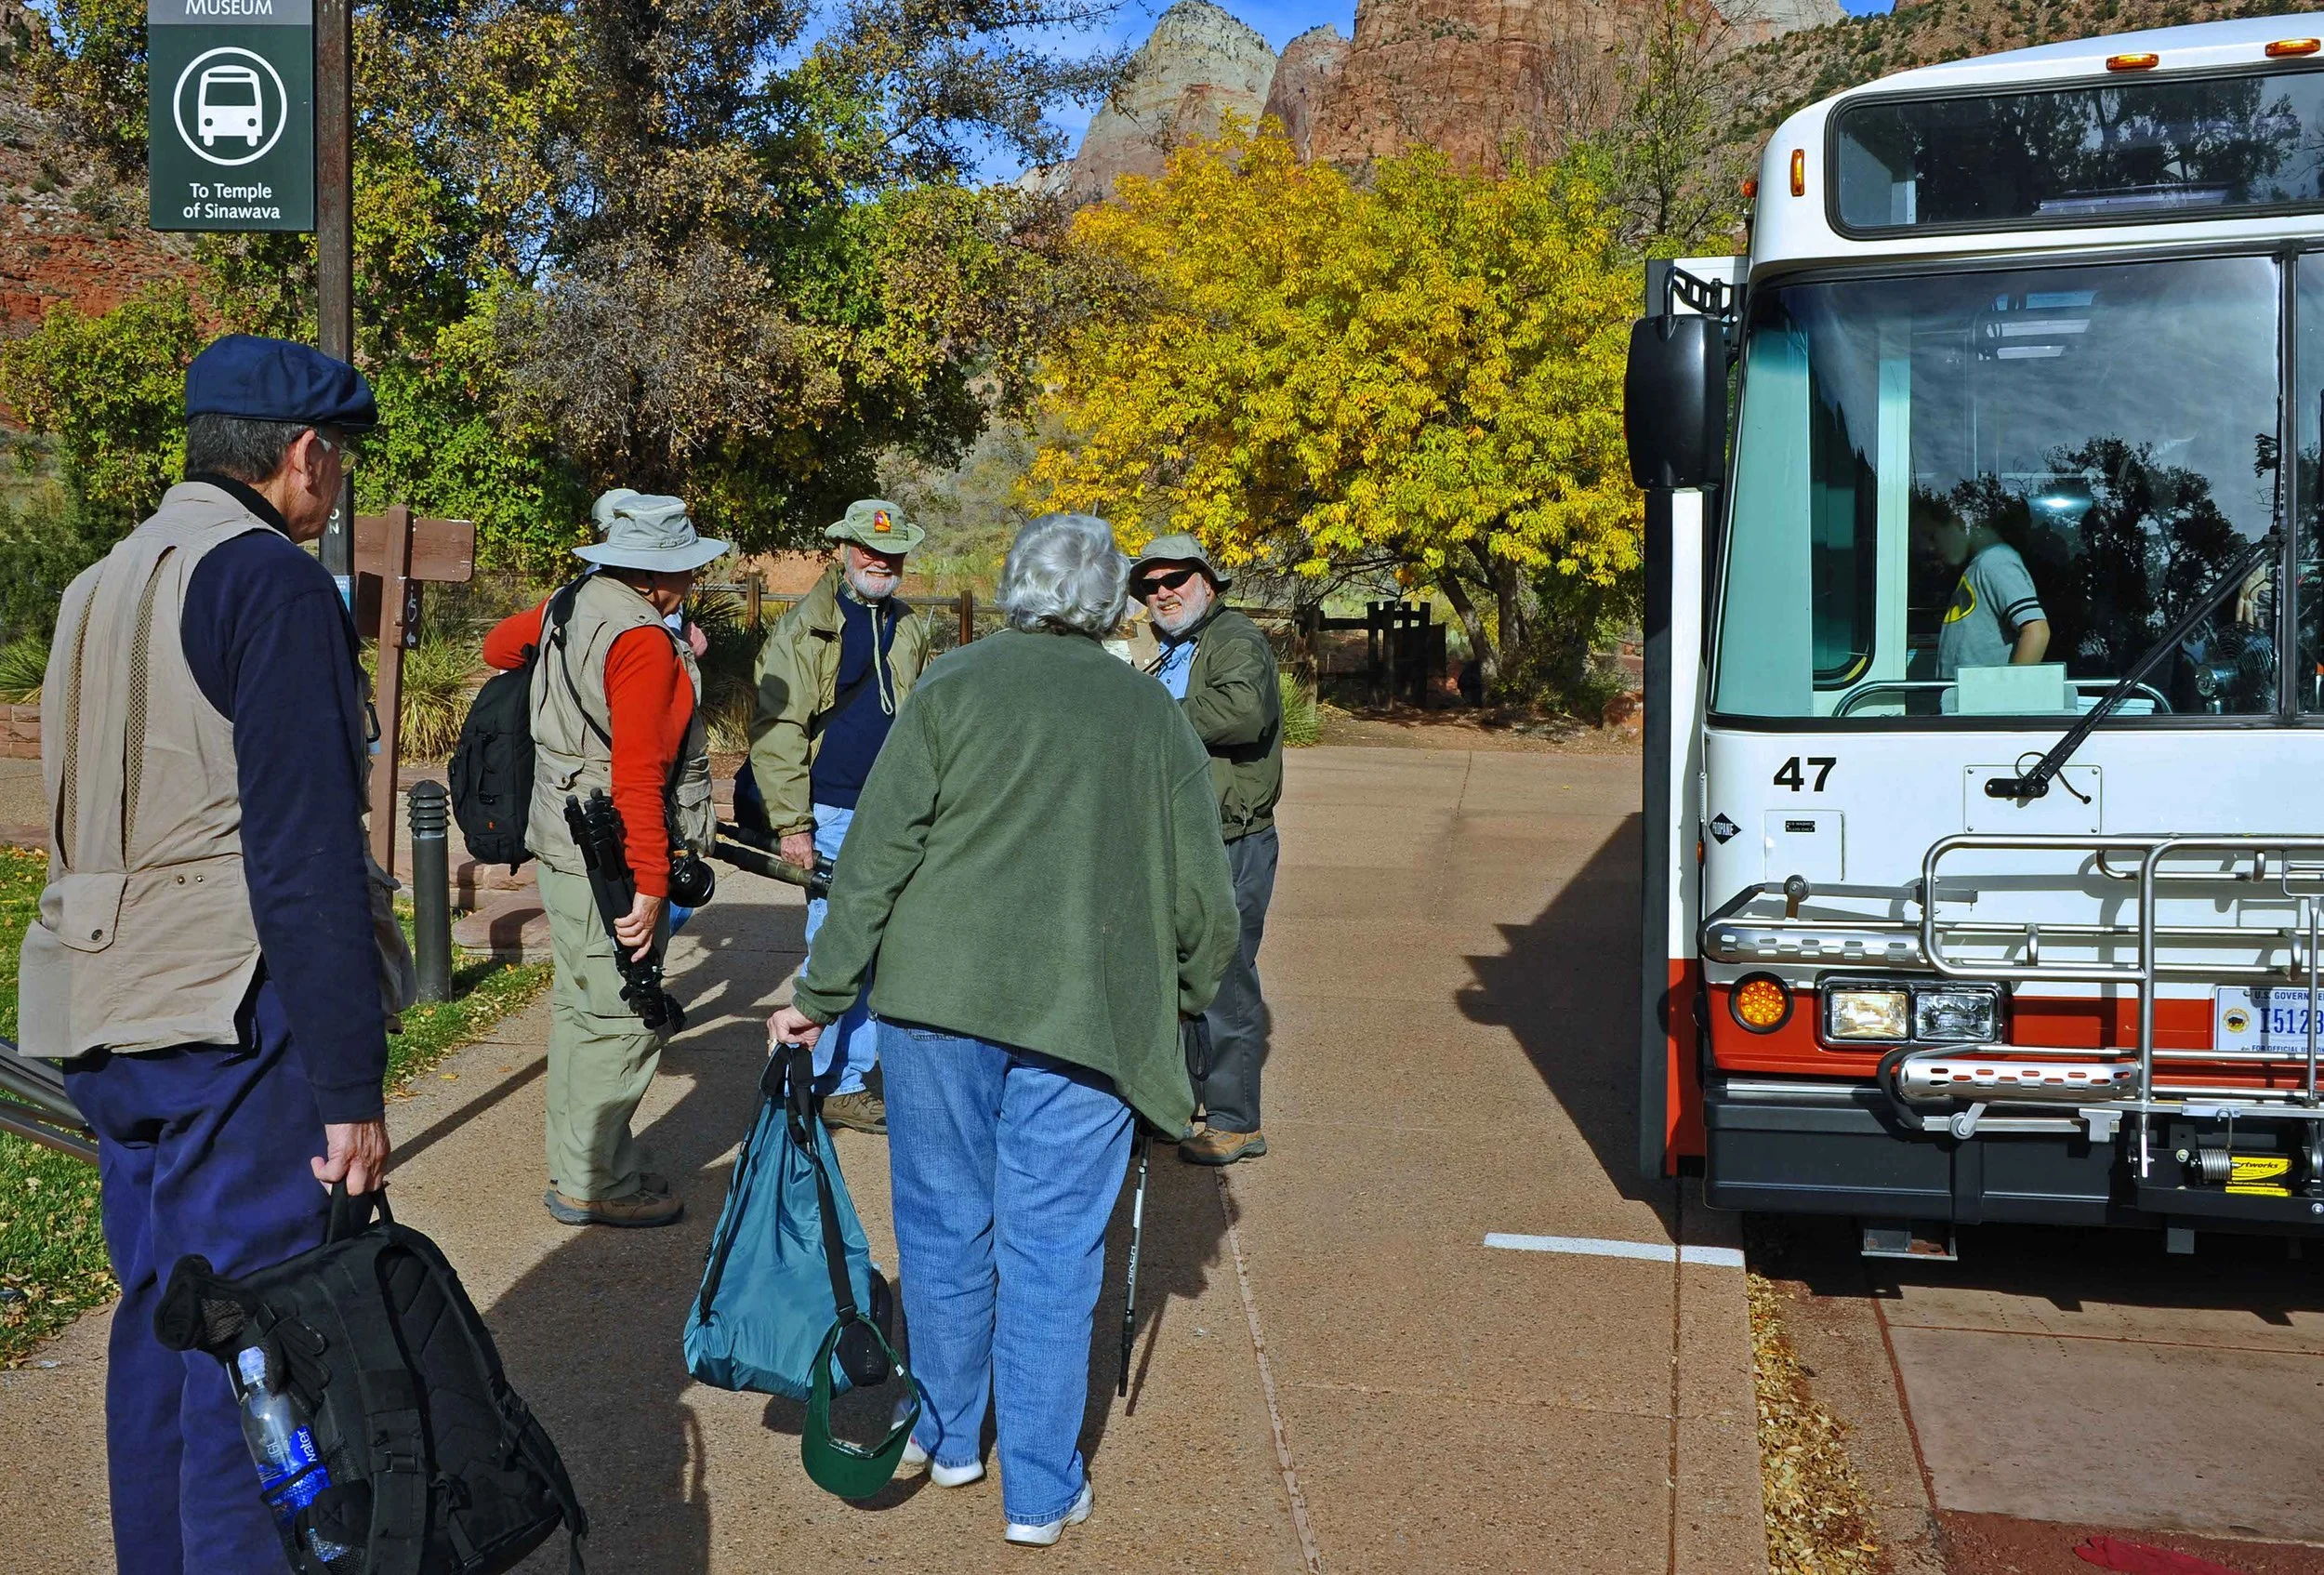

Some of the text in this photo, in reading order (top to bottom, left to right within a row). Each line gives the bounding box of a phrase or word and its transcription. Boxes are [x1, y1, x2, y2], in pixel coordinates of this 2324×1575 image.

[185, 0, 273, 16] MUSEUM
[190, 182, 272, 203] To Temple
[183, 202, 281, 219] of Sinawava
[1774, 757, 1836, 791] 47
[2254, 991, 2271, 999] U.S.
